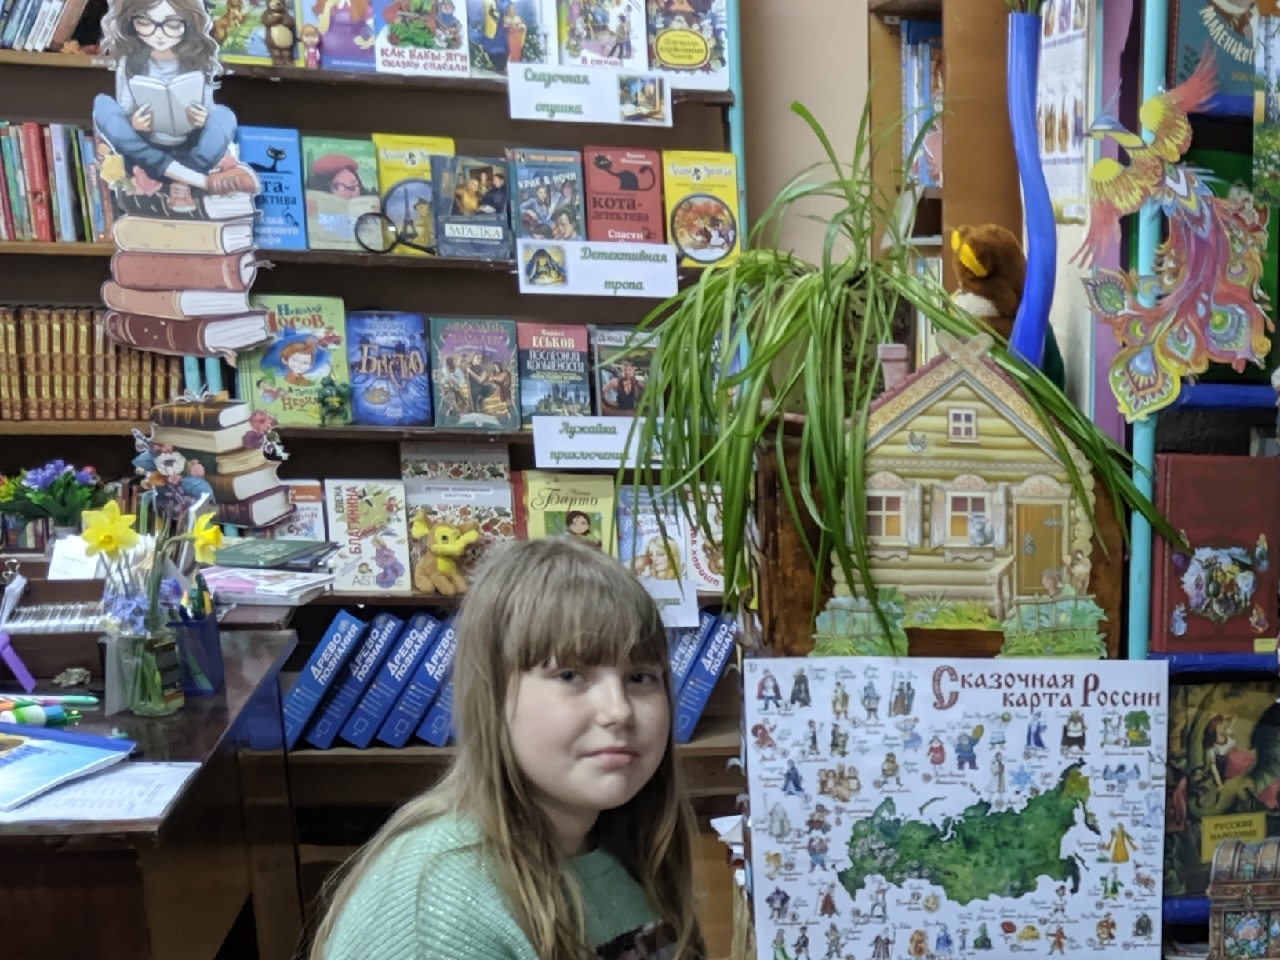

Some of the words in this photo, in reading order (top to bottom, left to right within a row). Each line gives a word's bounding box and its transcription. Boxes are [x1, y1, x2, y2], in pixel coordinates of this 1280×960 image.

[524, 68, 590, 88] Сказочная
[535, 102, 584, 118] опушка
[518, 177, 540, 189] КРИК
[553, 172, 577, 184] НОЧИ
[580, 247, 668, 263] Детективная
[604, 279, 644, 295] тропа
[532, 336, 576, 349] ЕСЬКОВ
[559, 421, 618, 439] Лужайка
[530, 487, 599, 512] Барто
[310, 632, 341, 680] ДРЕВО
[317, 623, 359, 686] ПОЗНАНИЯ
[350, 629, 380, 677] ДРЕВО
[356, 619, 396, 682] ПОЗНАНИЯ
[387, 629, 419, 677] ДРЕВО
[394, 620, 436, 682] ПОЗНАНИЯ
[424, 629, 455, 677] ДРЕВО
[701, 623, 728, 672] ДРЕВО
[932, 665, 1075, 711] Сказочная
[1002, 692, 1072, 714] карта
[1081, 673, 1161, 708] России
[1214, 820, 1253, 831] РУССКИЕ
